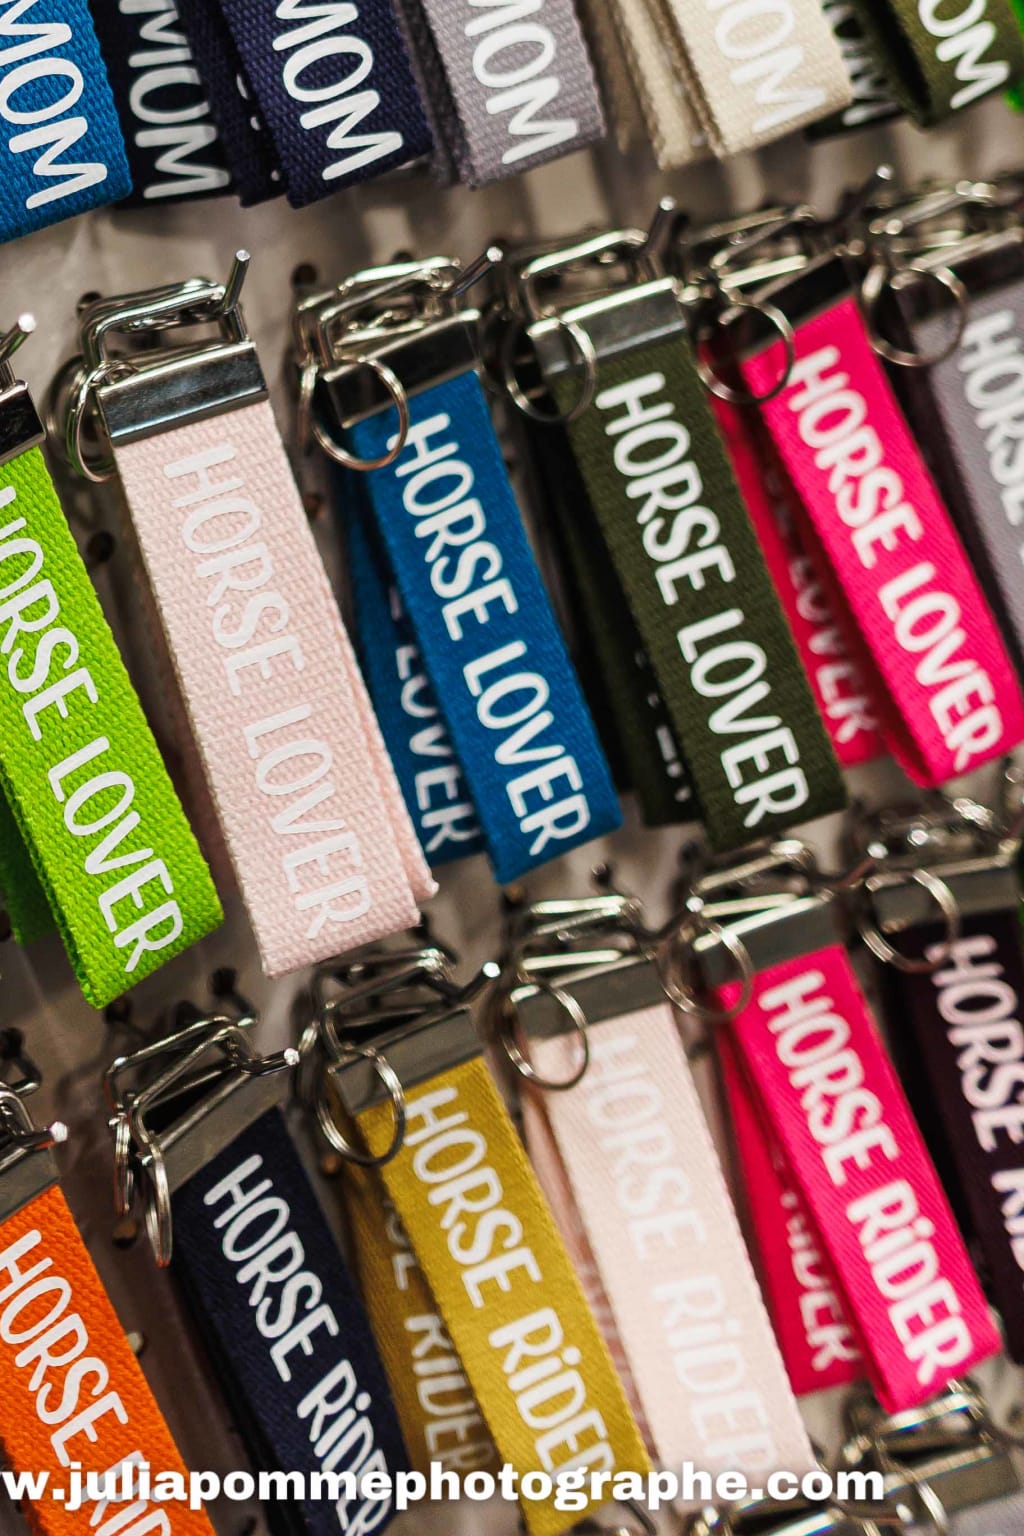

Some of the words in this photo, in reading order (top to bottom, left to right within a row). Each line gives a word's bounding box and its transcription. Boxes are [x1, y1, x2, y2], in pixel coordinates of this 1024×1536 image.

[386, 412, 519, 642] HORSE
[463, 641, 591, 857] LOVER
[594, 371, 737, 606] HORSE
[677, 608, 811, 828] LOVER
[785, 345, 924, 570] HORSE
[876, 561, 1005, 772] LOVER
[163, 444, 307, 697] HORSE
[245, 704, 373, 941] LOVER
[46, 736, 184, 973] LOVER
[584, 1034, 709, 1262] HORSE
[758, 969, 900, 1186] HORSE
[203, 1153, 339, 1382] HORSE
[400, 1086, 542, 1309] HORSE
